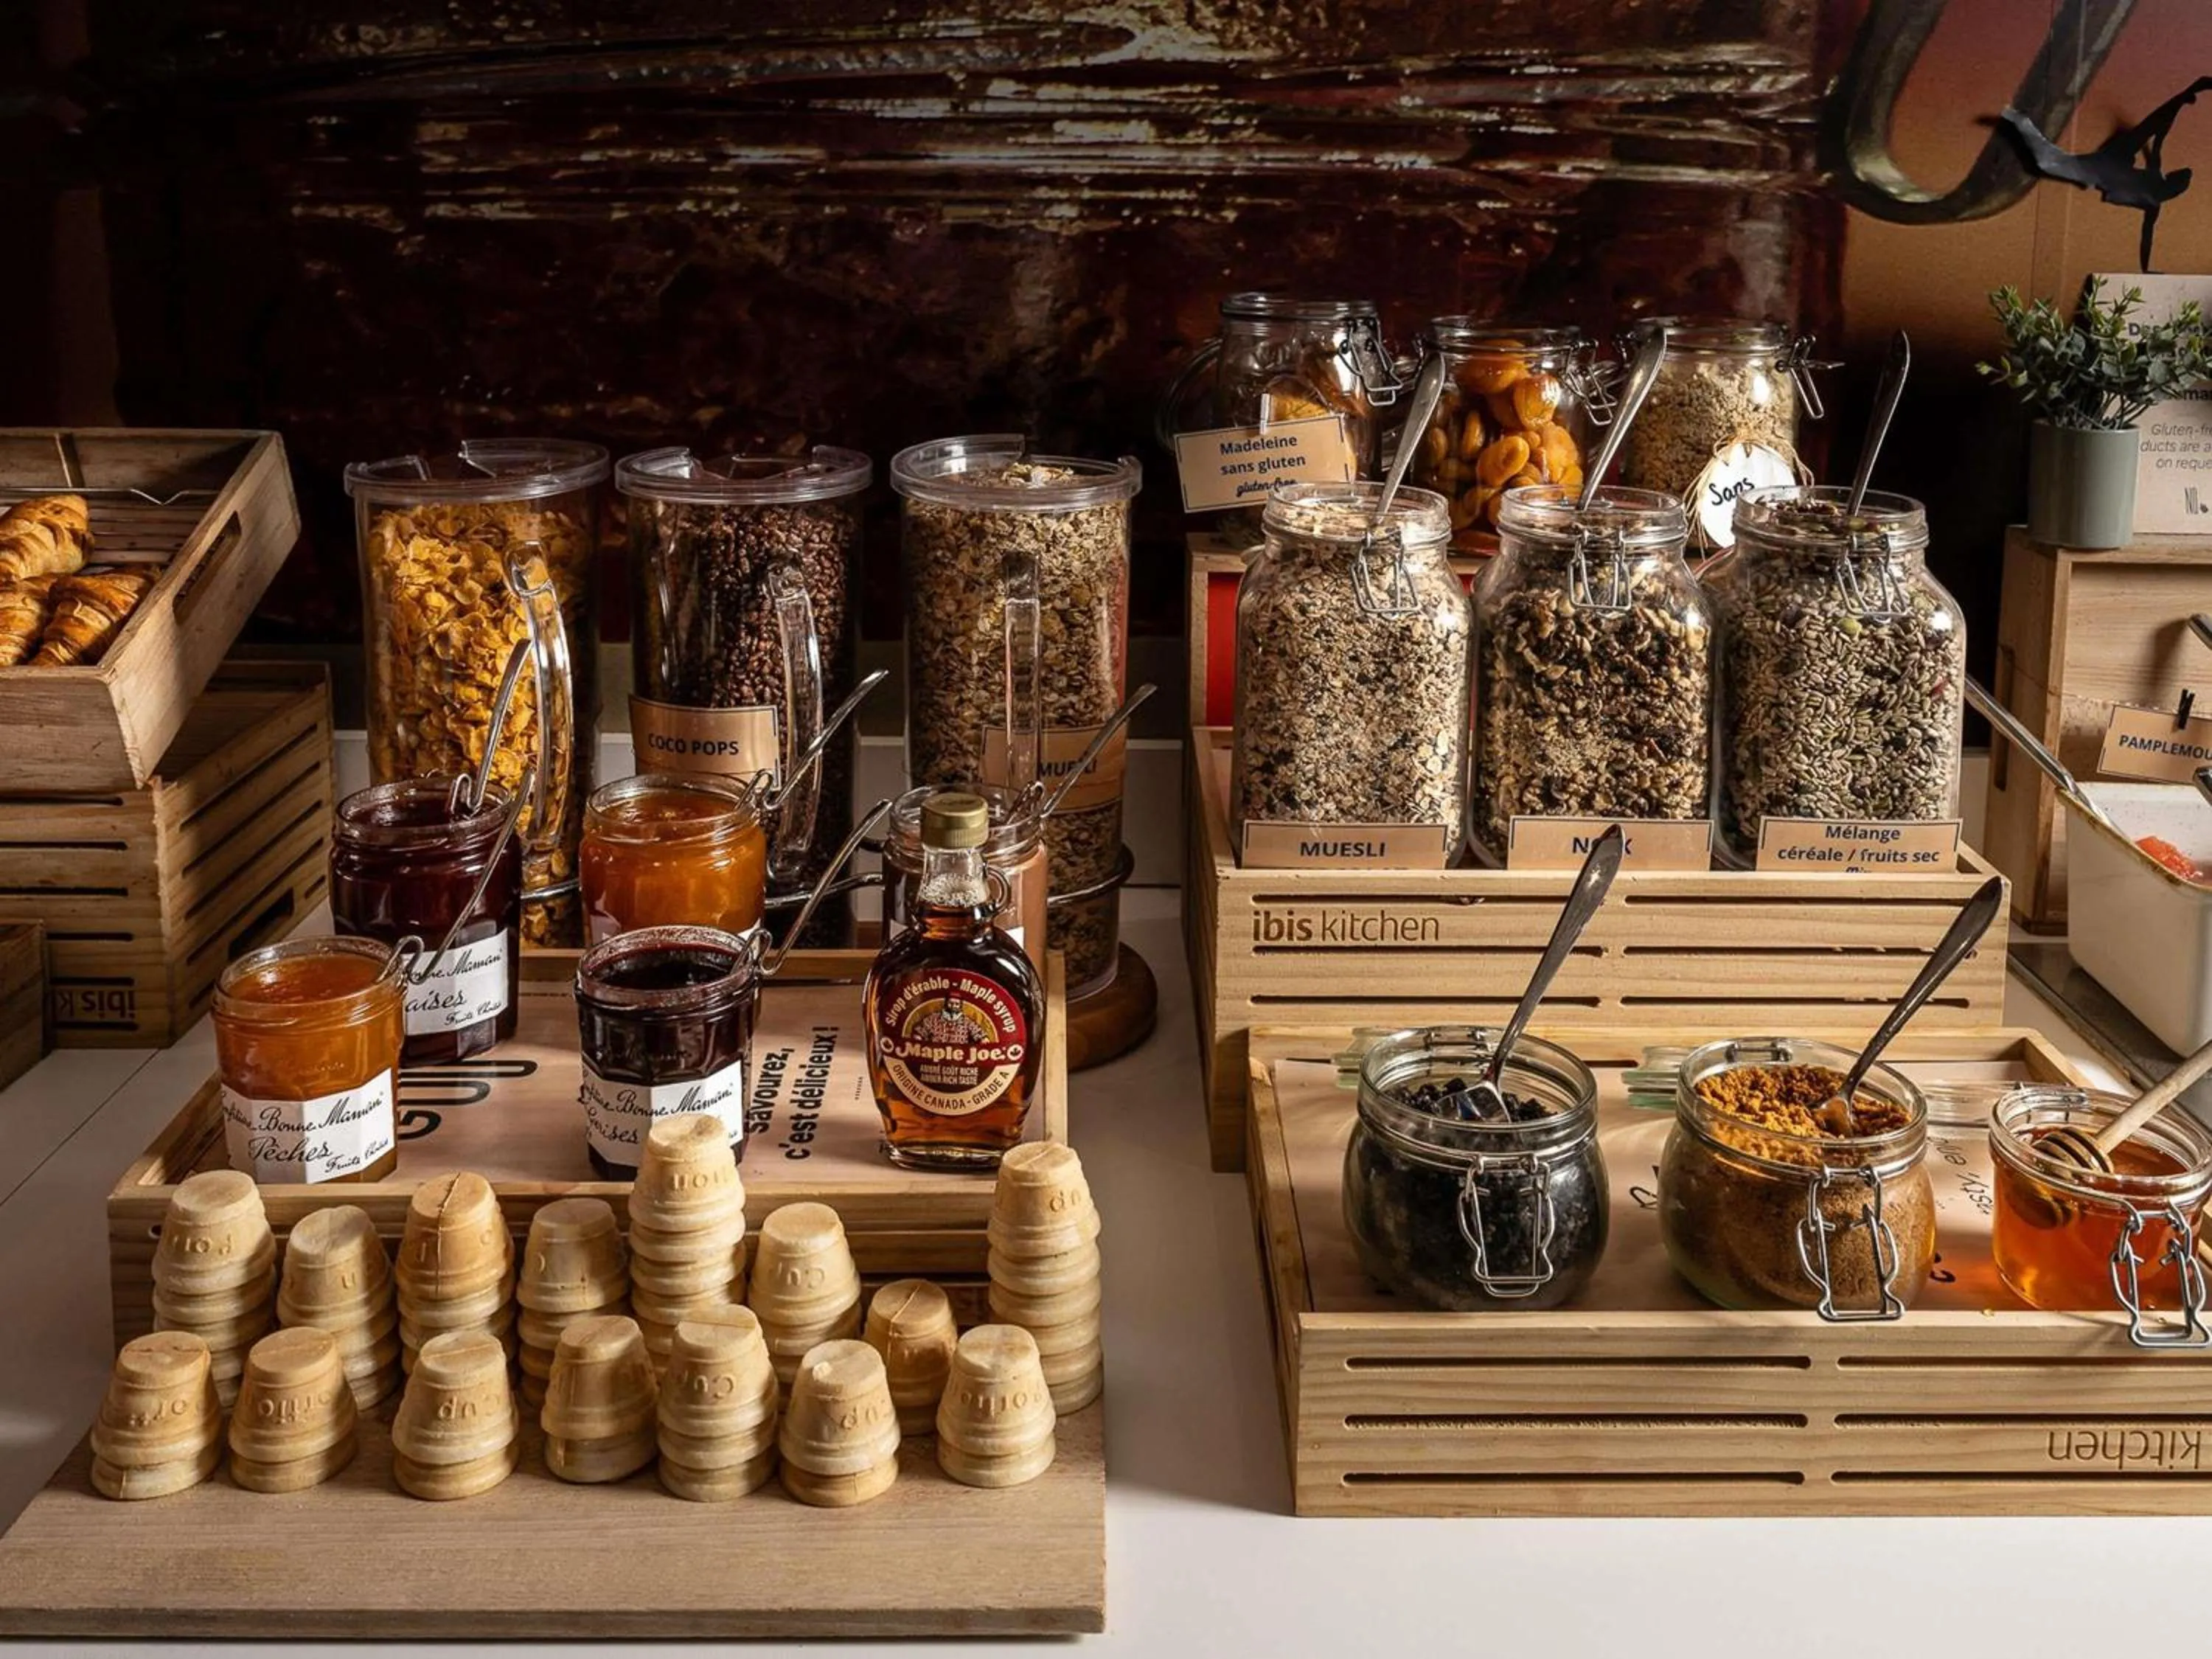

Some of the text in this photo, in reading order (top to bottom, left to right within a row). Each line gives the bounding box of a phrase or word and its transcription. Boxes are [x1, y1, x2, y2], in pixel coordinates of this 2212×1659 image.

[1220, 435, 1298, 455] Madeleine
[1220, 455, 1307, 476] sans gluten
[1708, 477, 1756, 507] Sans
[648, 733, 740, 756] COCO POPS
[1825, 824, 1901, 844] Mélange
[1300, 841, 1385, 858] MUESLI
[1778, 846, 1843, 861] céréale
[1860, 849, 1907, 863] fruits
[1912, 852, 1941, 863] sec
[1253, 910, 1440, 942] ibis kitchen
[81, 990, 136, 1019] ibis
[406, 990, 467, 1012] aises
[886, 998, 907, 1027] Sirop
[960, 978, 996, 1004] Maple
[894, 1041, 964, 1062] Maple
[893, 1064, 925, 1100] ORIGINE
[925, 1094, 966, 1110] CANADA
[972, 1079, 1004, 1105] GRADE
[999, 1071, 1009, 1081] A
[778, 1113, 820, 1160] c'est
[2049, 1430, 2201, 1470] kitchen
